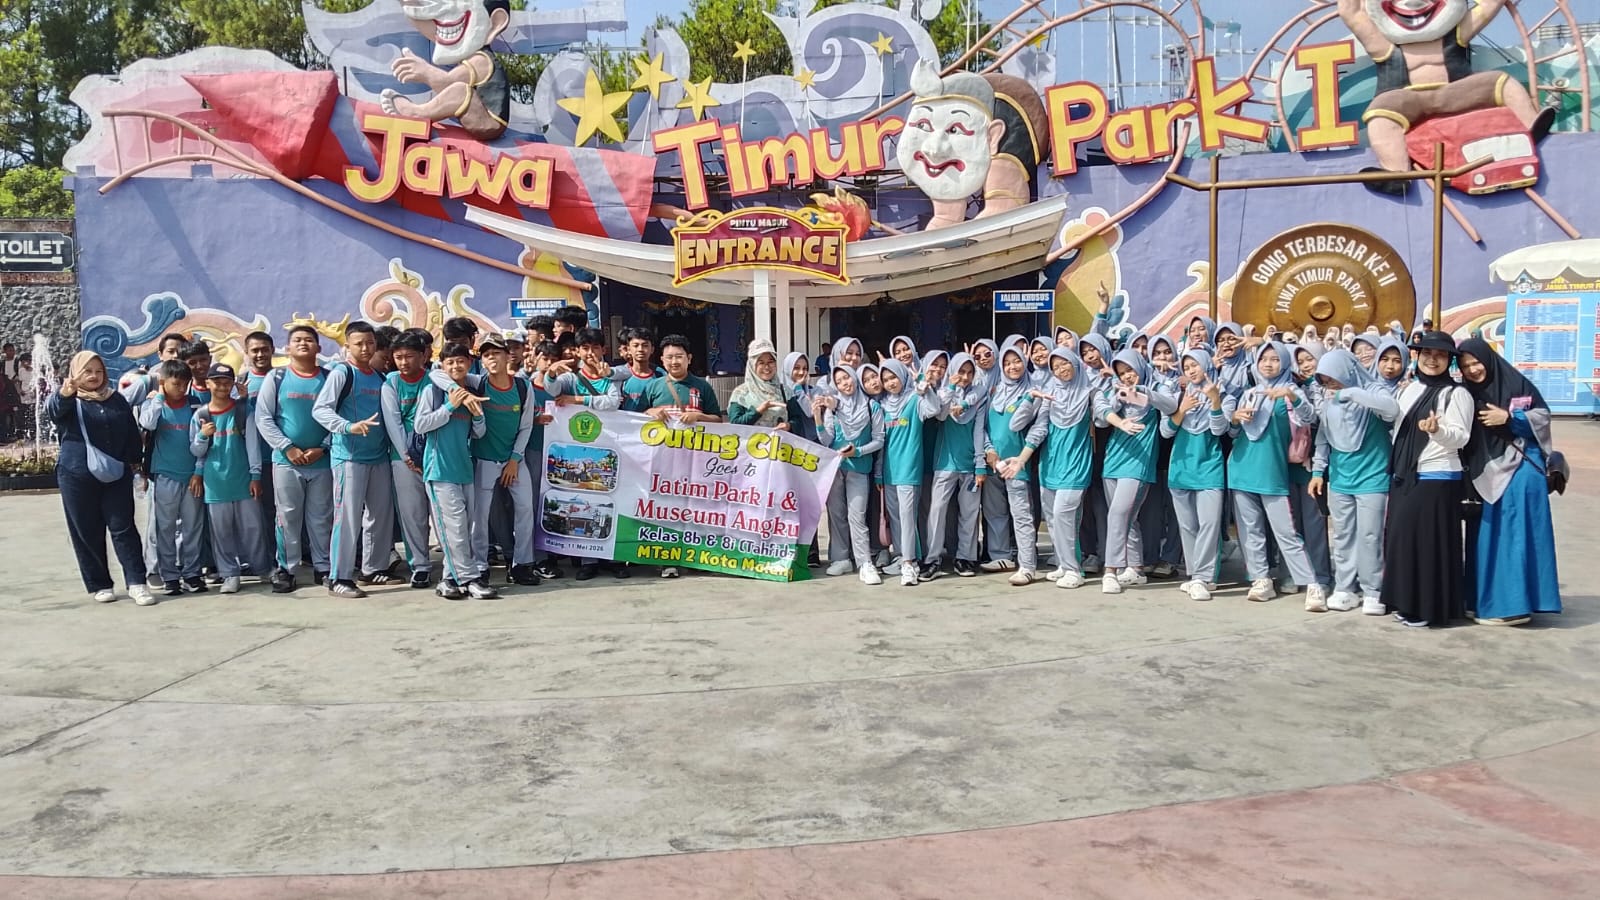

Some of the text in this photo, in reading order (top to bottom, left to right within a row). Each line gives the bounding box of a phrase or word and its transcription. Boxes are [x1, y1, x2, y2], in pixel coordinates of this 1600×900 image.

[344, 39, 1359, 211] Jawa Timur Park I
[730, 217, 789, 227] PINTU MASUK
[0, 240, 64, 255] TOILET
[681, 236, 840, 270] ENTRANCE
[1252, 249, 1288, 285] GONG
[1284, 235, 1368, 261] TERBESAR
[1363, 252, 1390, 277] KE
[1275, 281, 1296, 313] JAWA
[1293, 268, 1334, 287] TIMUR
[1336, 271, 1366, 303] PARK
[640, 420, 820, 472] Outing Class
[703, 457, 757, 477] Goes to
[650, 473, 709, 498] Jatim
[713, 480, 761, 506] Park
[781, 491, 798, 511] &
[635, 498, 727, 527] Museum
[639, 527, 679, 543] Kelas
[683, 531, 701, 545] 8b
[706, 535, 716, 547] &
[637, 545, 682, 560] MTsN
[685, 550, 695, 561] 2
[699, 550, 738, 569] Kota
